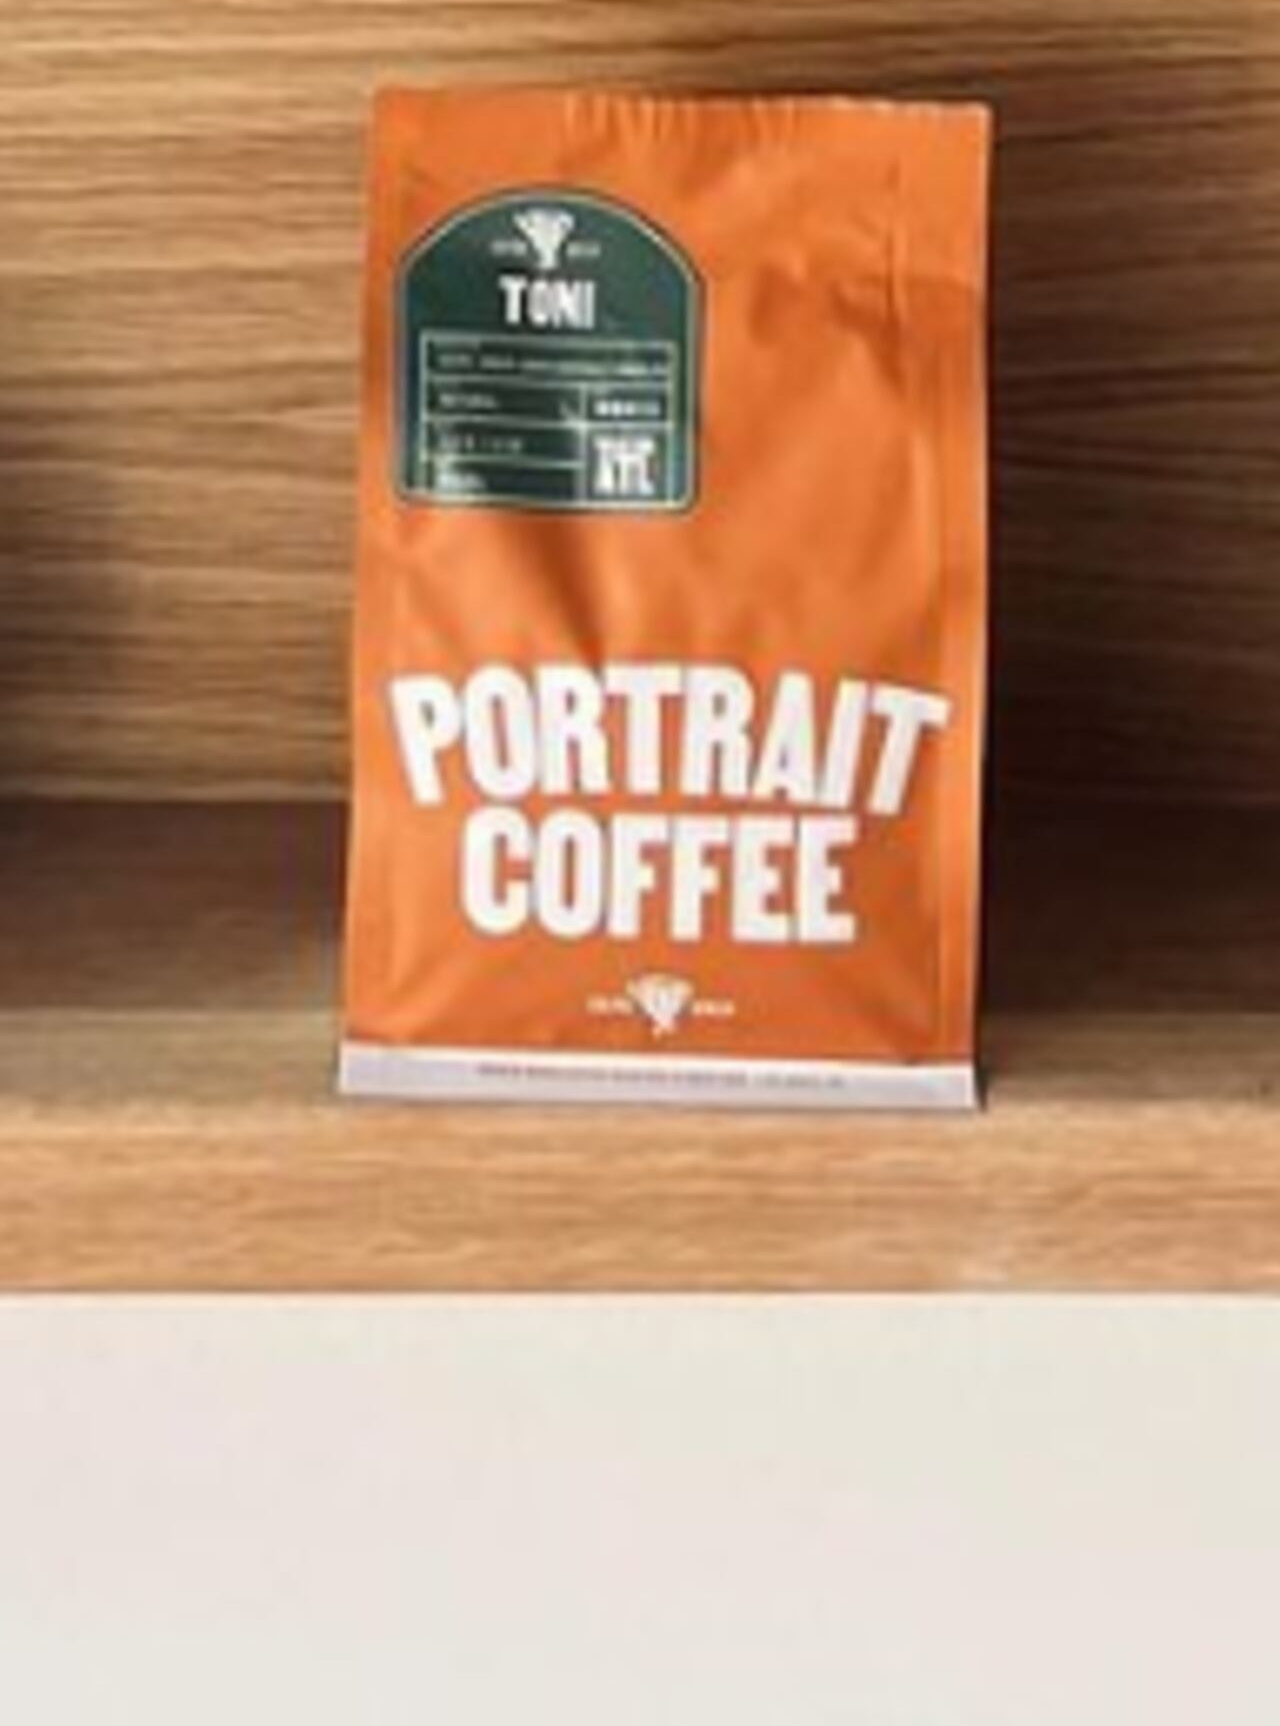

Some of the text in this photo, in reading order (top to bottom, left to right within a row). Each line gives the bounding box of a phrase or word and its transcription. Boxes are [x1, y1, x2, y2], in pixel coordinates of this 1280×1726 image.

[498, 274, 596, 330] TONI
[390, 663, 954, 815] PORTRAIT
[462, 805, 856, 943] COFFEE
